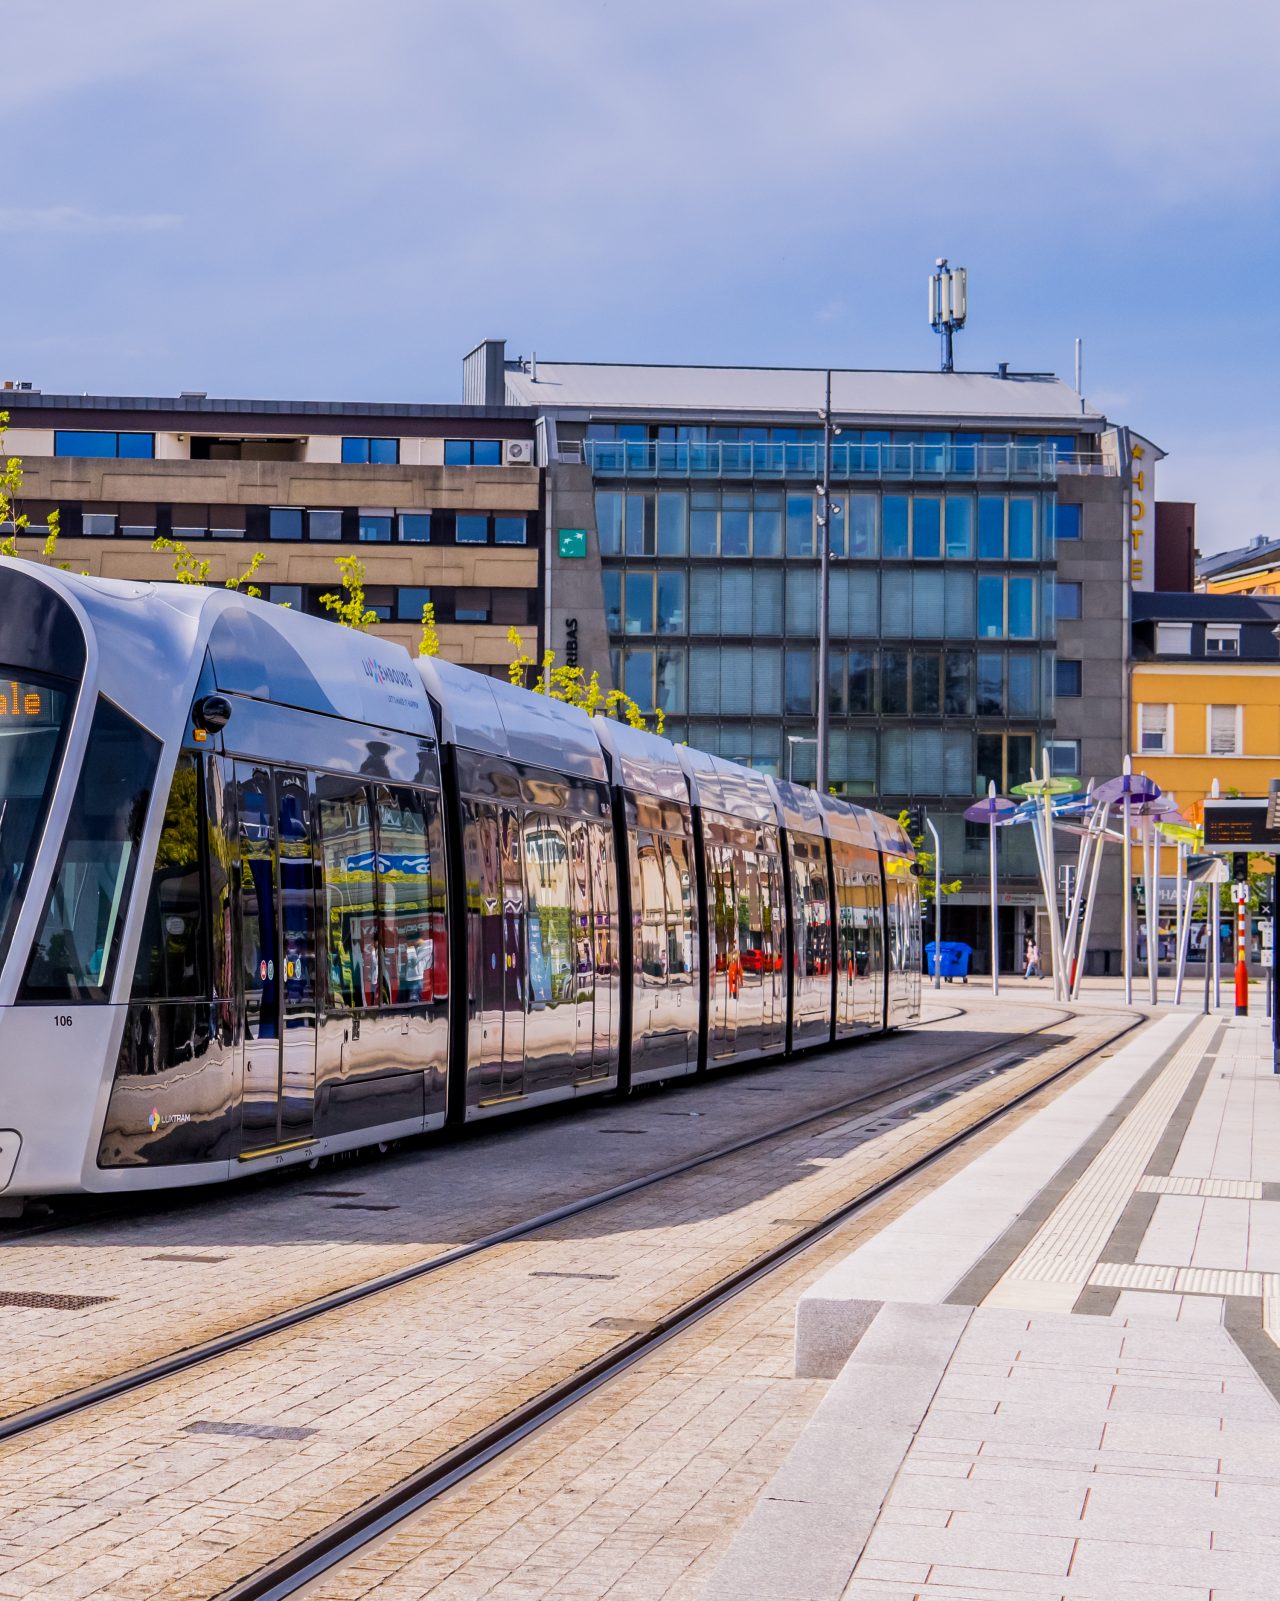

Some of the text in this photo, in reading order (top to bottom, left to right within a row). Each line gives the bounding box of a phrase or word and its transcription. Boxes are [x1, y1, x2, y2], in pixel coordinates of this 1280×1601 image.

[566, 618, 578, 668] RIBAS
[53, 1015, 73, 1027] 106
[161, 1114, 191, 1124] LUXTRAM
